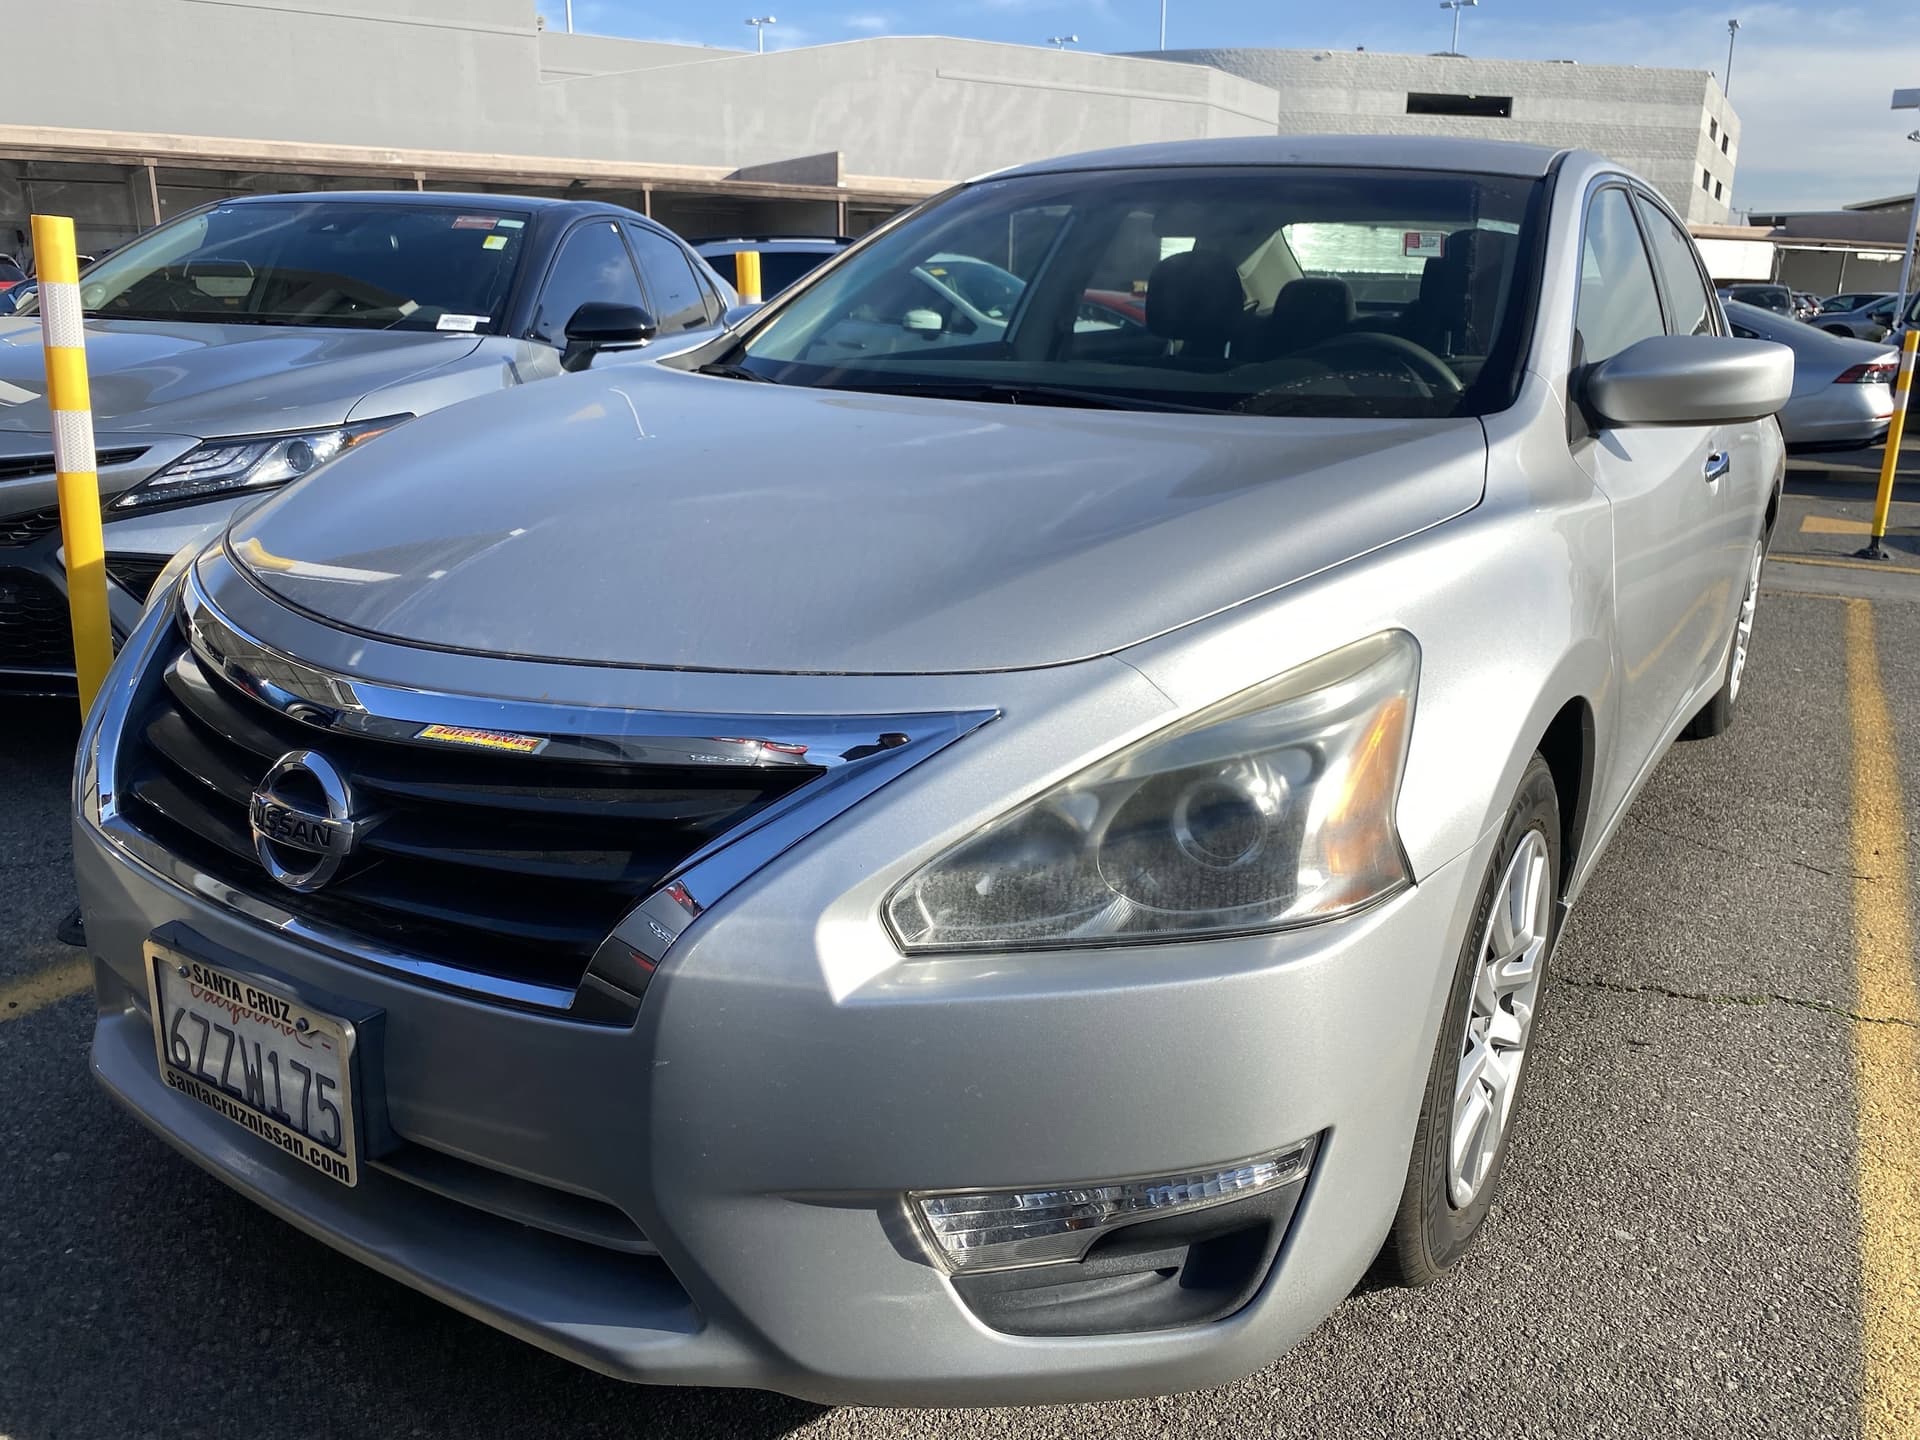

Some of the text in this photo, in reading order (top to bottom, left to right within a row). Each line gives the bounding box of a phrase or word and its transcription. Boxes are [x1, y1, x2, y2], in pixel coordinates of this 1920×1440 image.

[253, 798, 332, 848] NISSAN
[193, 963, 292, 1025] SANTA CRUZ
[170, 1007, 342, 1150] 6ZZW175
[167, 1070, 350, 1183] santacruznissan.com
